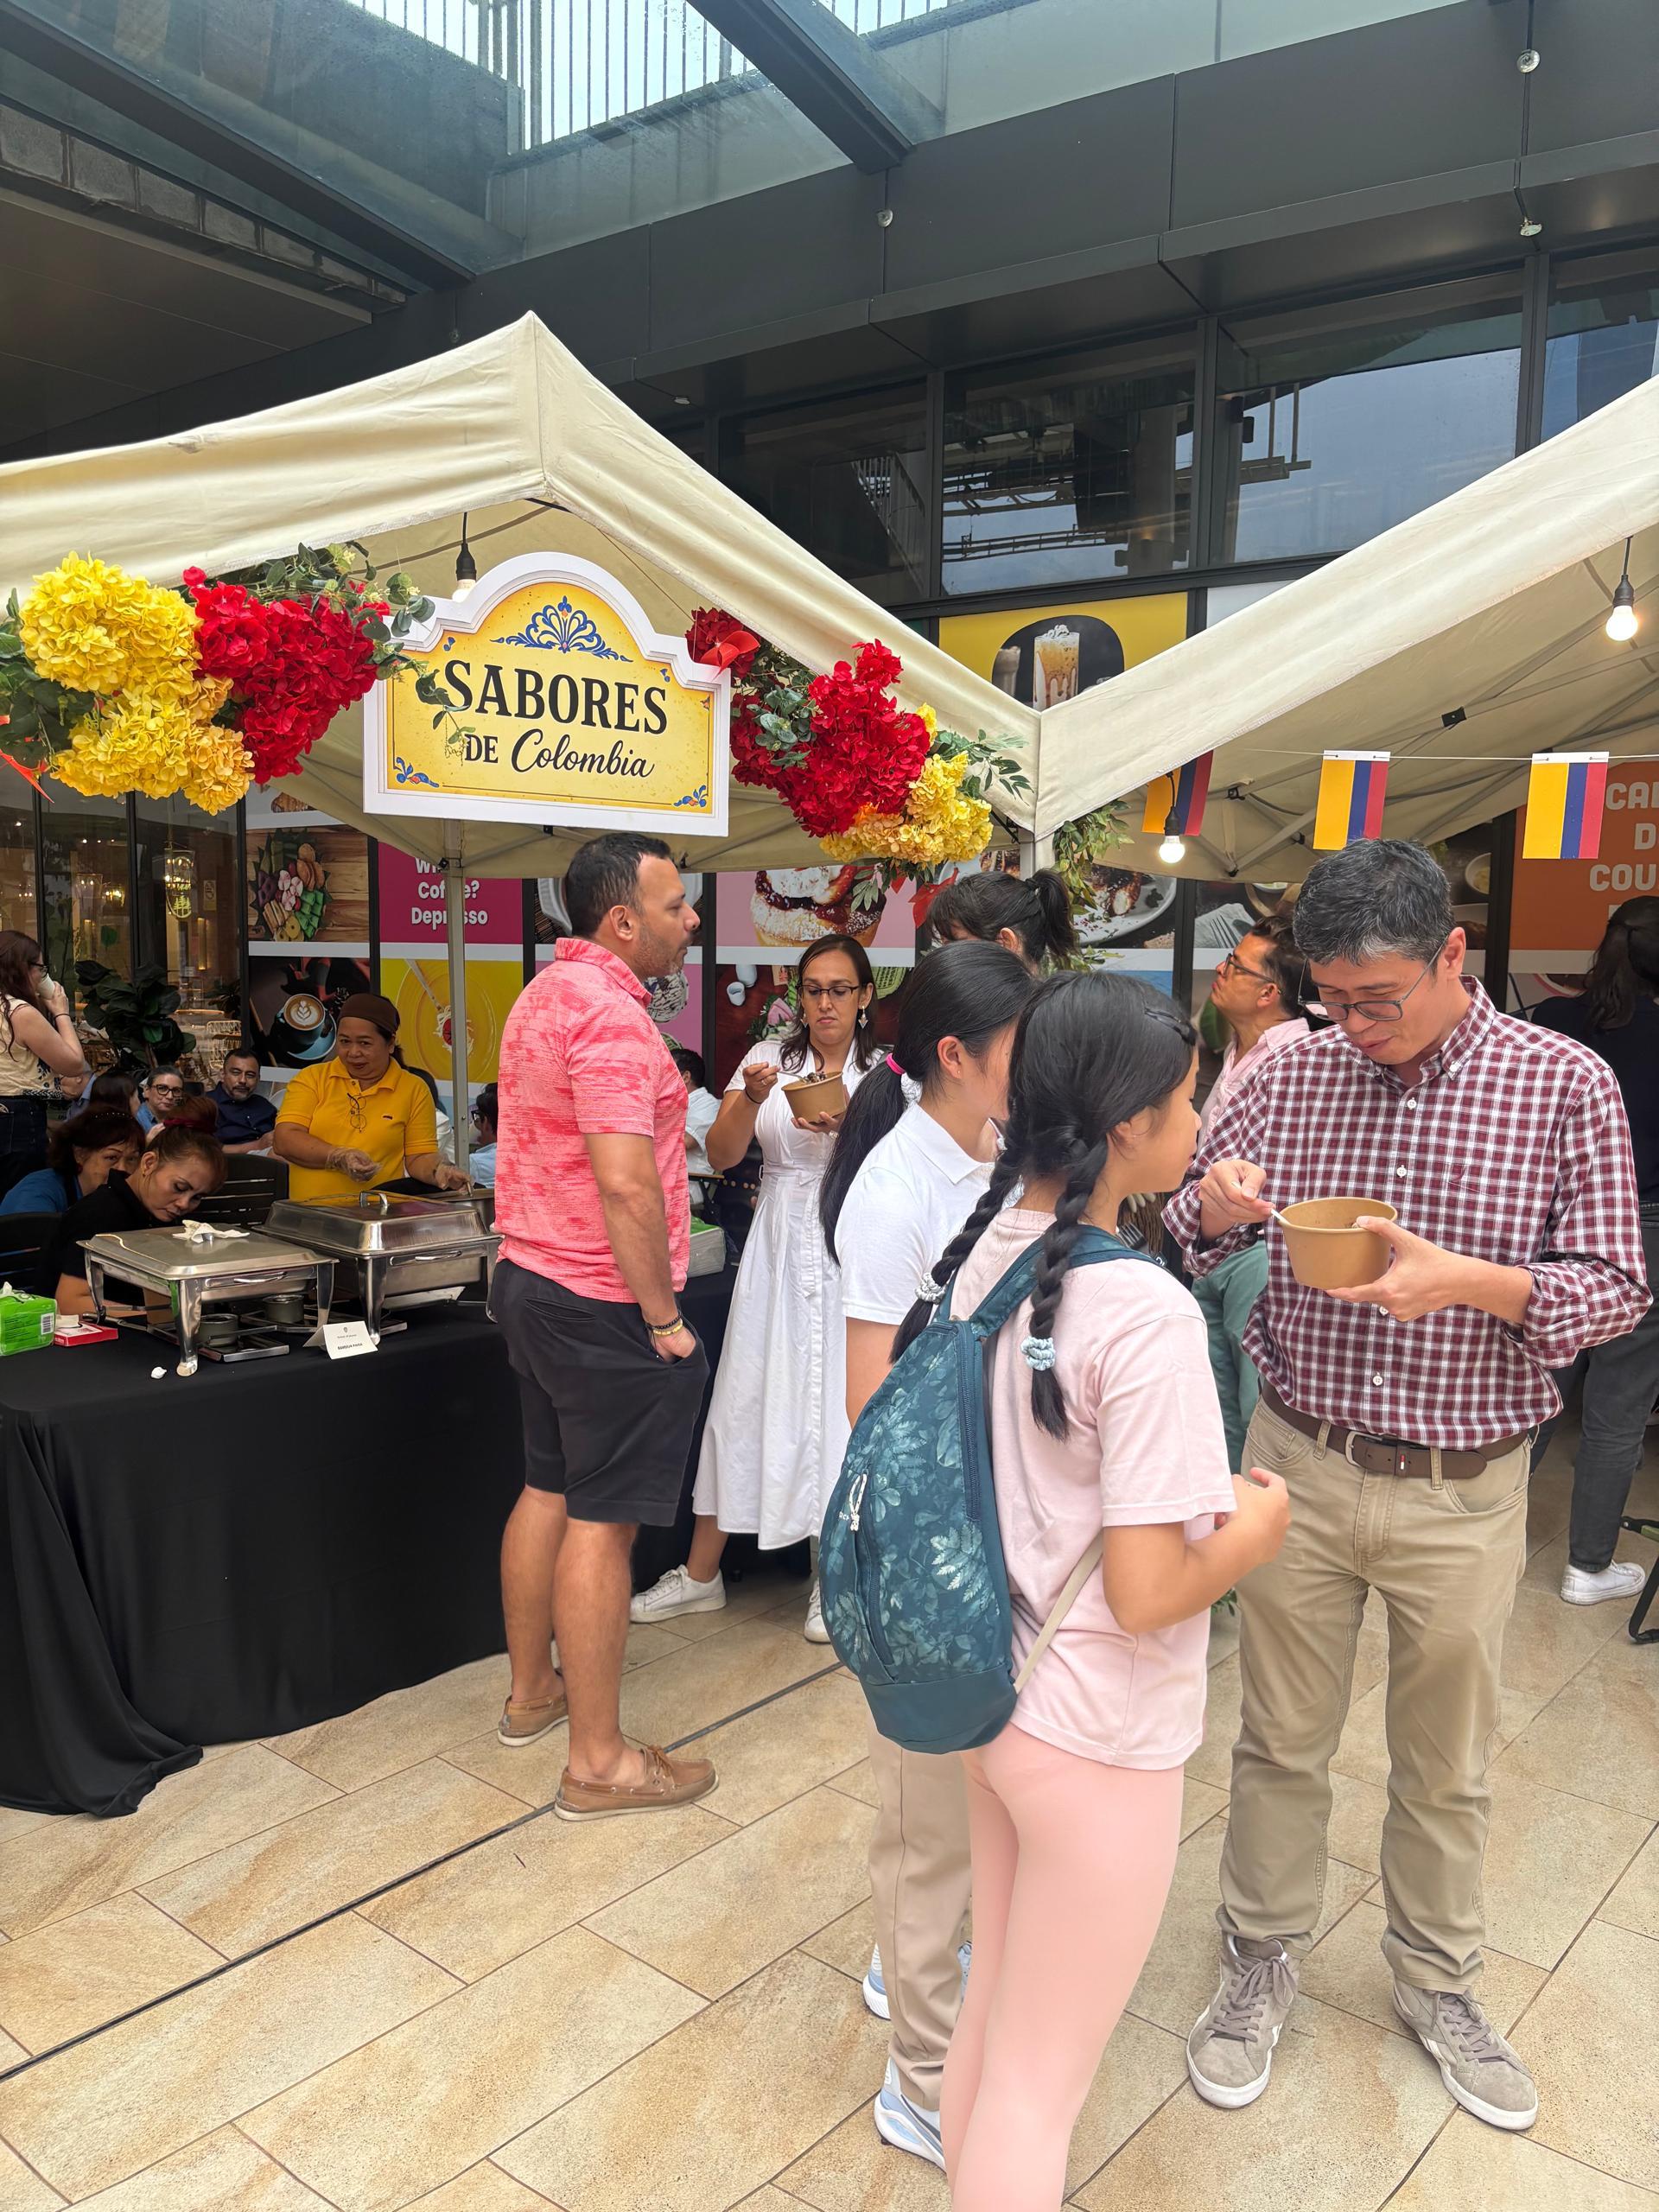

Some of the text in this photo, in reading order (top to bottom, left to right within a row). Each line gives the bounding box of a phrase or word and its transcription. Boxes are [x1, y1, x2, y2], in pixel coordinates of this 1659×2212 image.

[444, 659, 667, 735] SABORES
[463, 728, 656, 778] DE Colombia
[418, 880, 480, 899] Cofe?
[1590, 863, 1659, 892] COU
